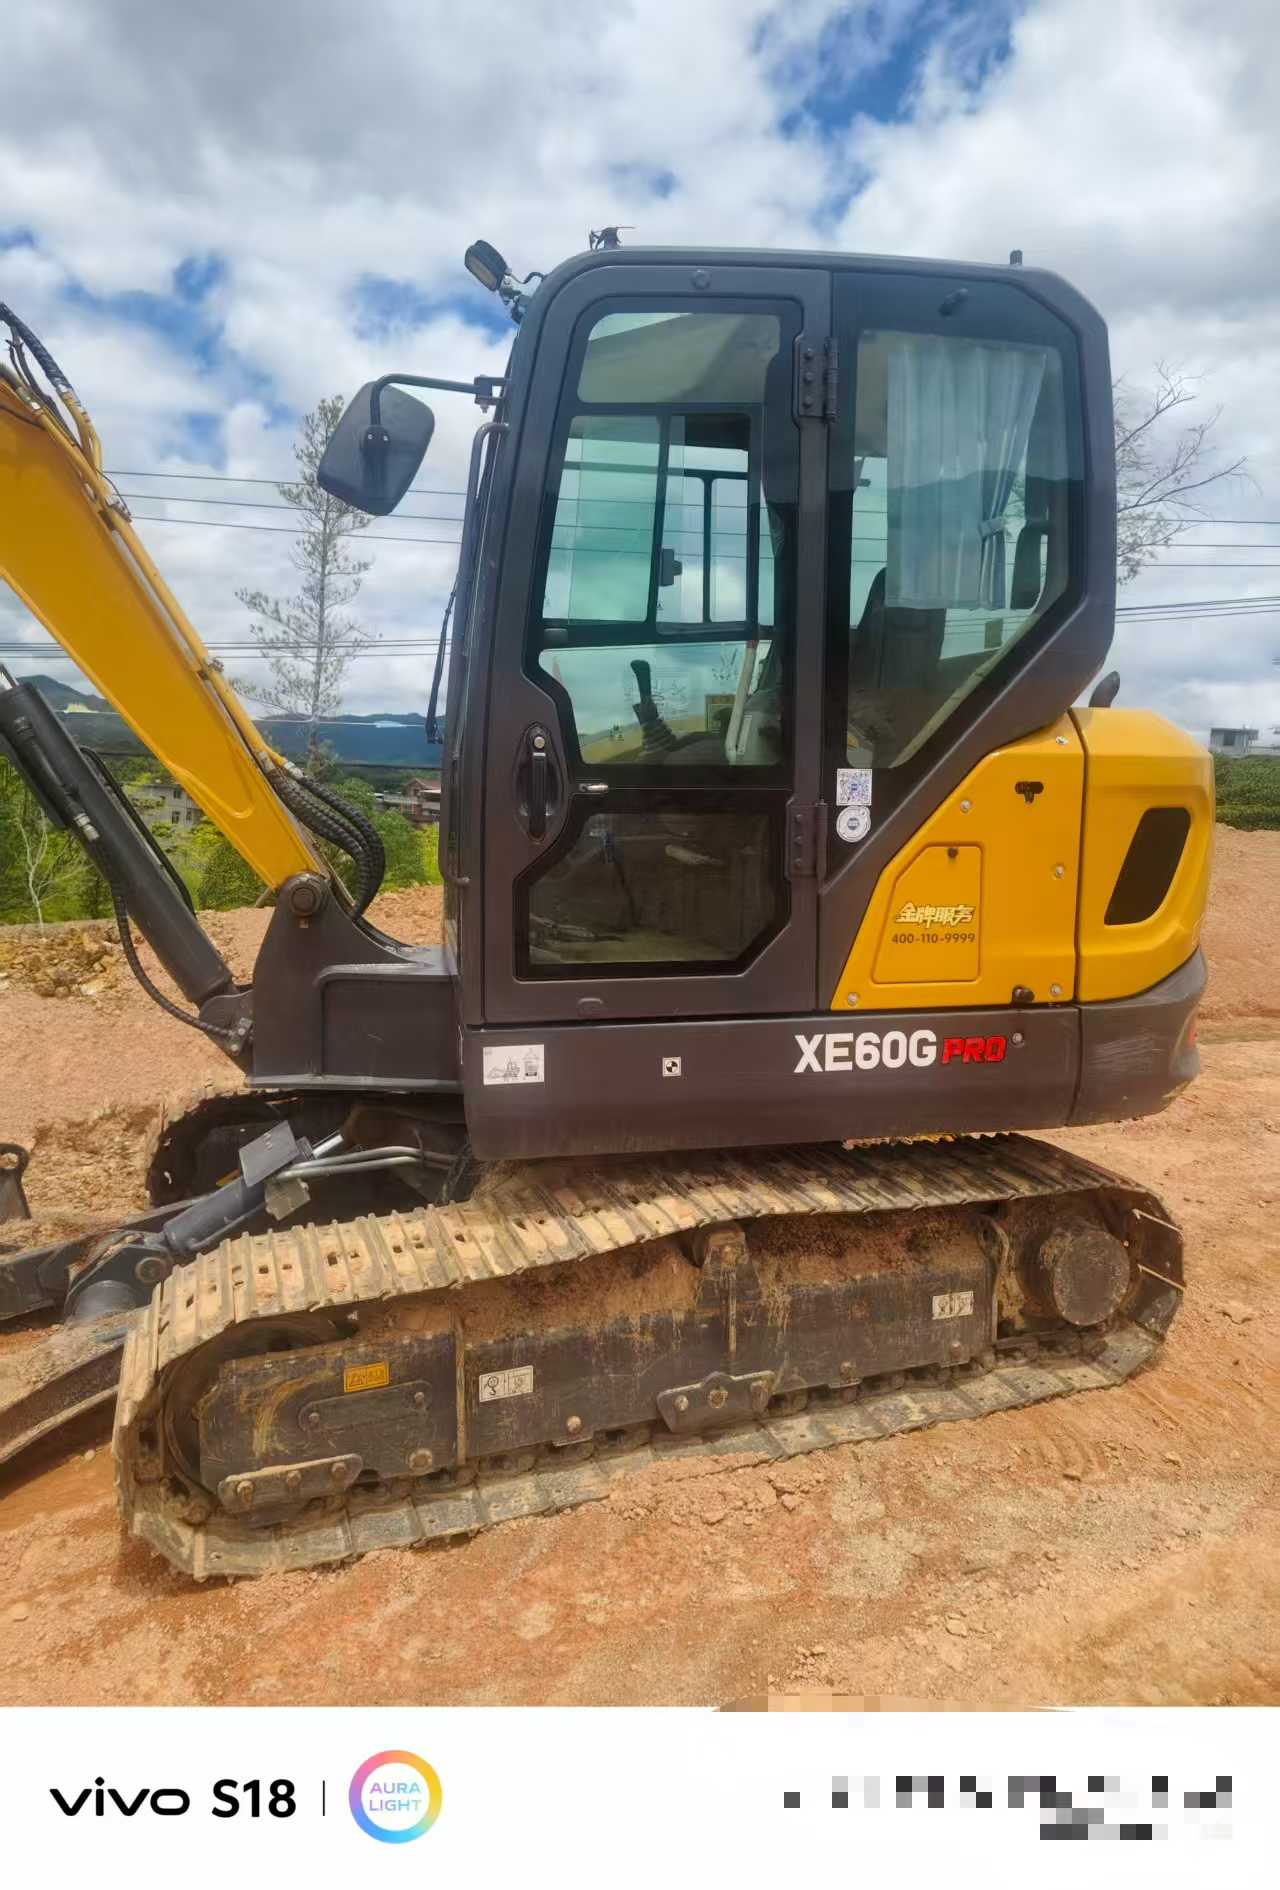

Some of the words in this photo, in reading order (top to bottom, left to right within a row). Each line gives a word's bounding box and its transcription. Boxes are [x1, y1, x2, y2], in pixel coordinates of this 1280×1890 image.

[895, 901, 975, 928] 金牌服务
[892, 933, 975, 944] 400-110-9999
[793, 1029, 937, 1074] XE60G
[942, 1034, 1007, 1065] PRO
